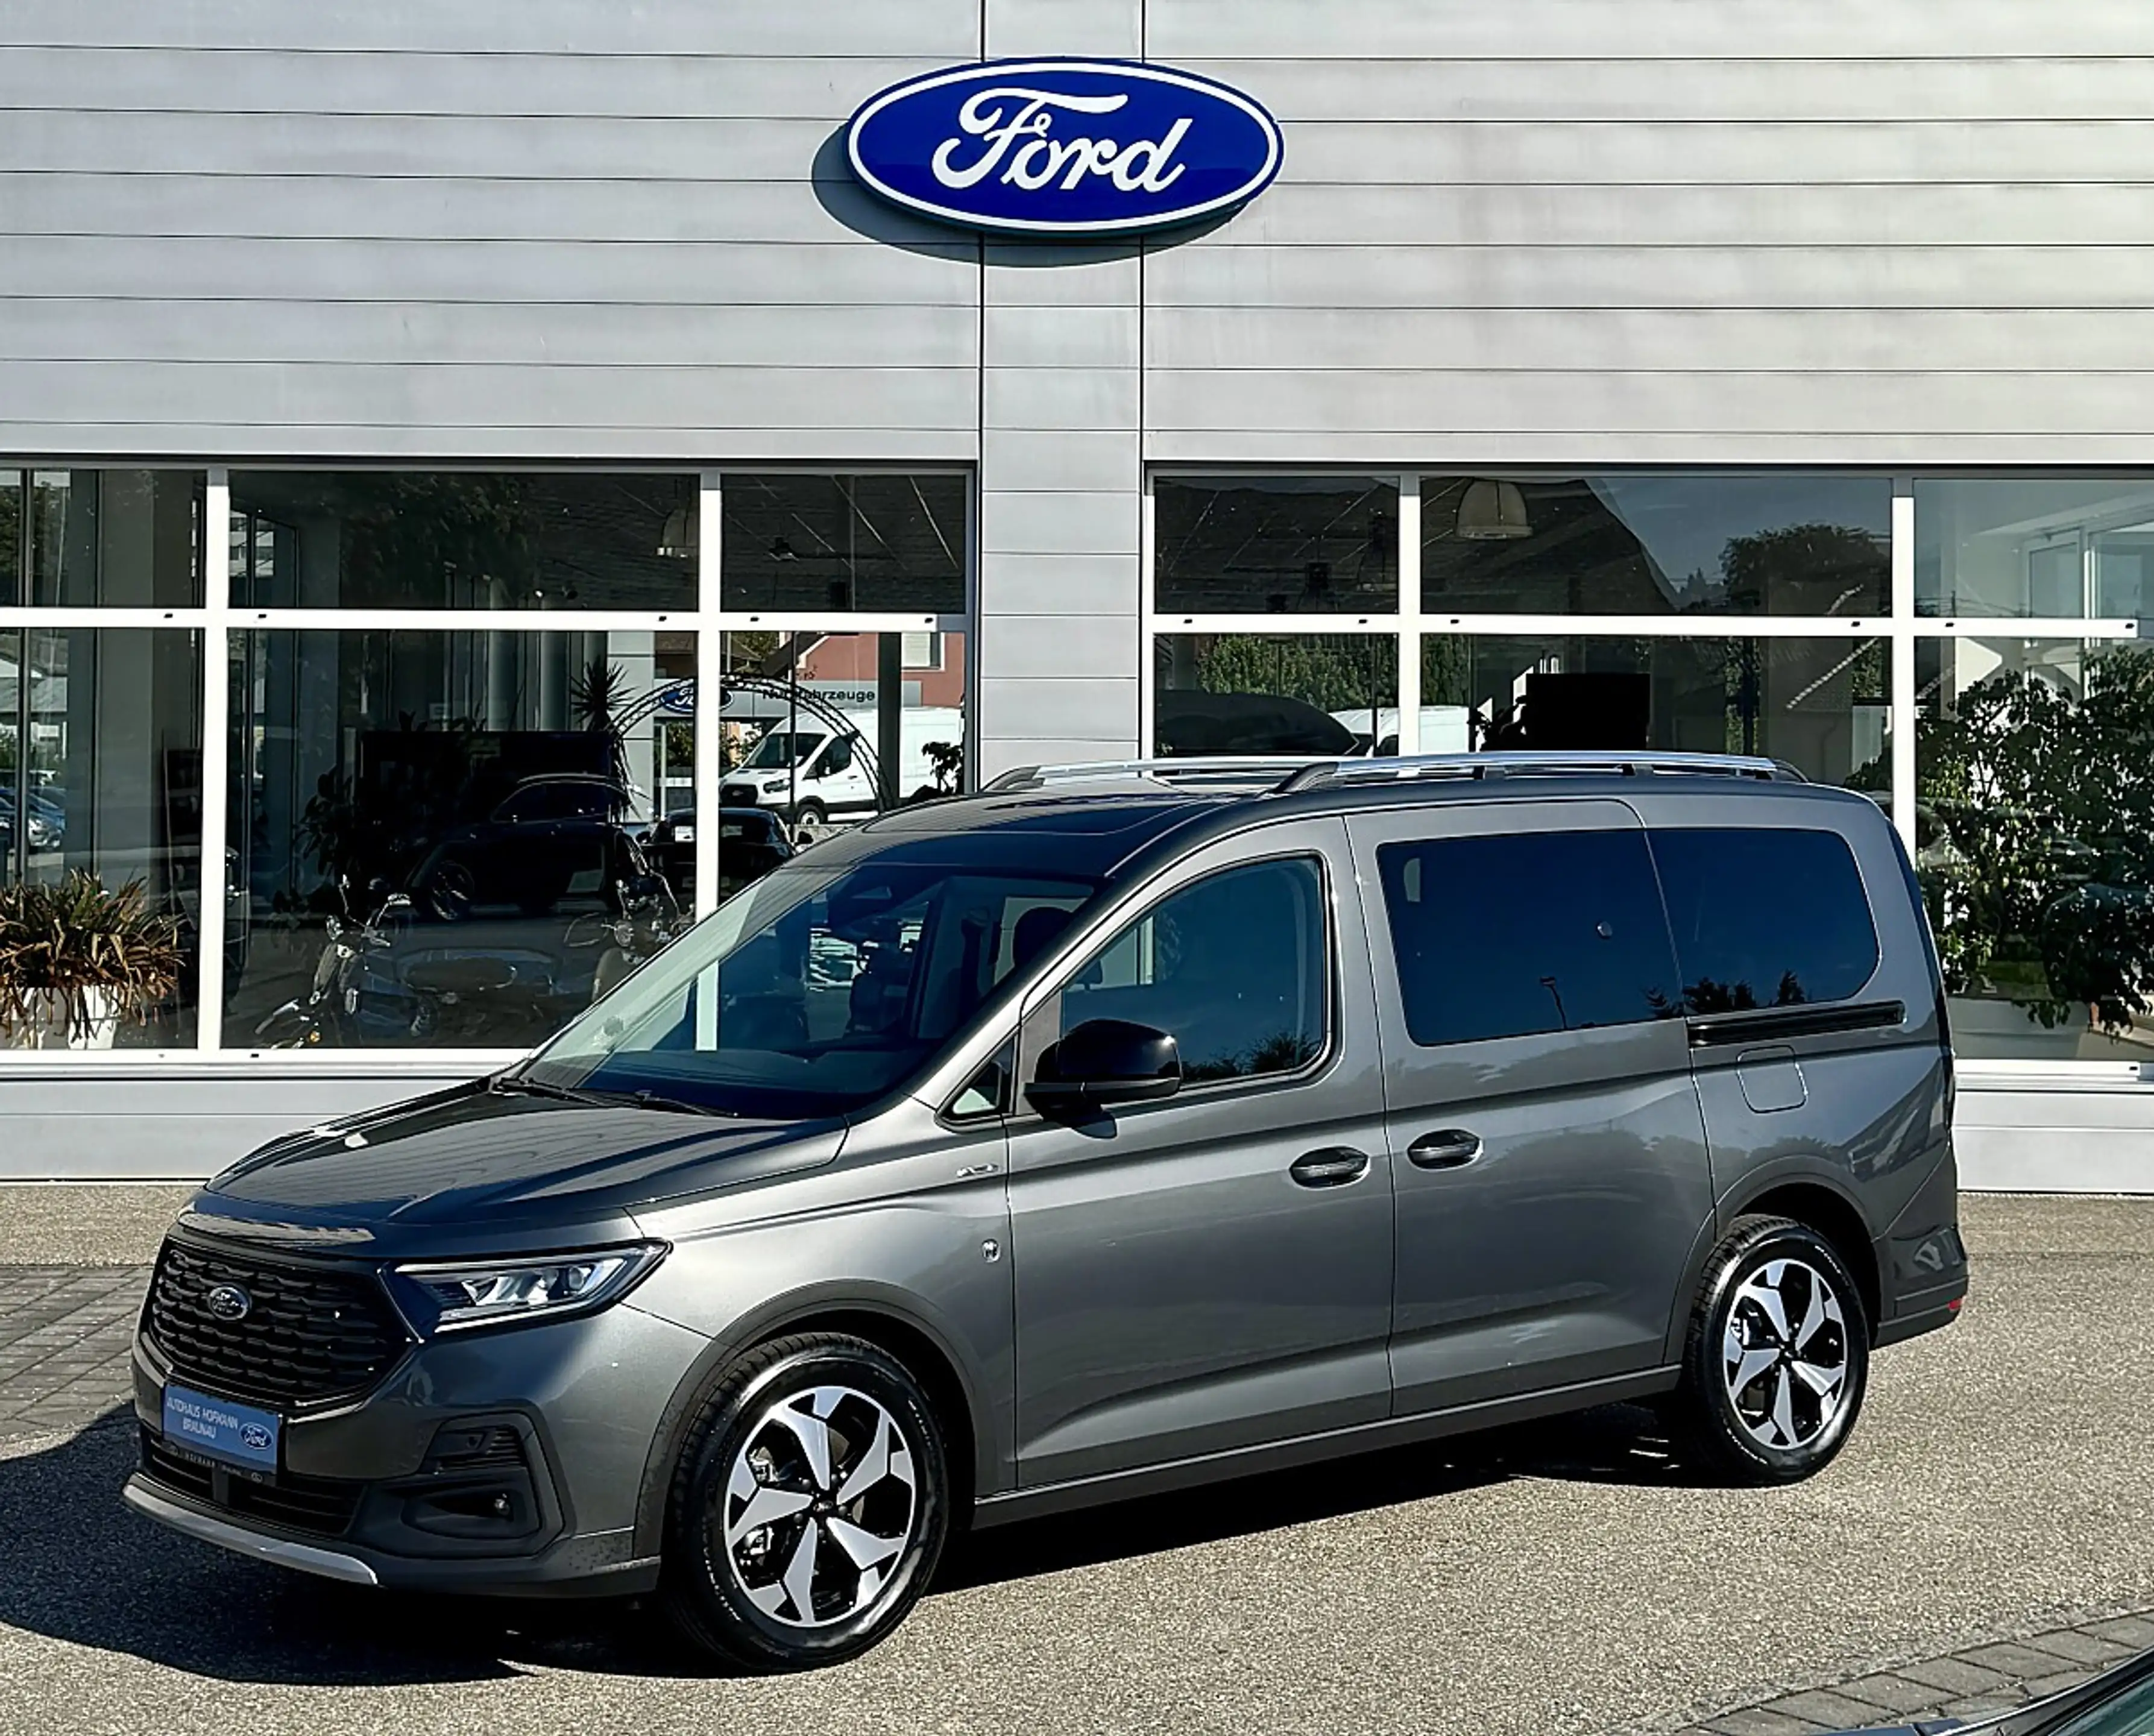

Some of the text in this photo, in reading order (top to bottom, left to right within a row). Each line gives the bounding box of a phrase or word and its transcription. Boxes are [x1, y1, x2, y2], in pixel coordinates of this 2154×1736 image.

[932, 87, 1193, 192] Ford
[167, 1397, 200, 1418] AUTOHAUS
[183, 1417, 216, 1439] BRAUNAU
[244, 1426, 266, 1446] Ford
